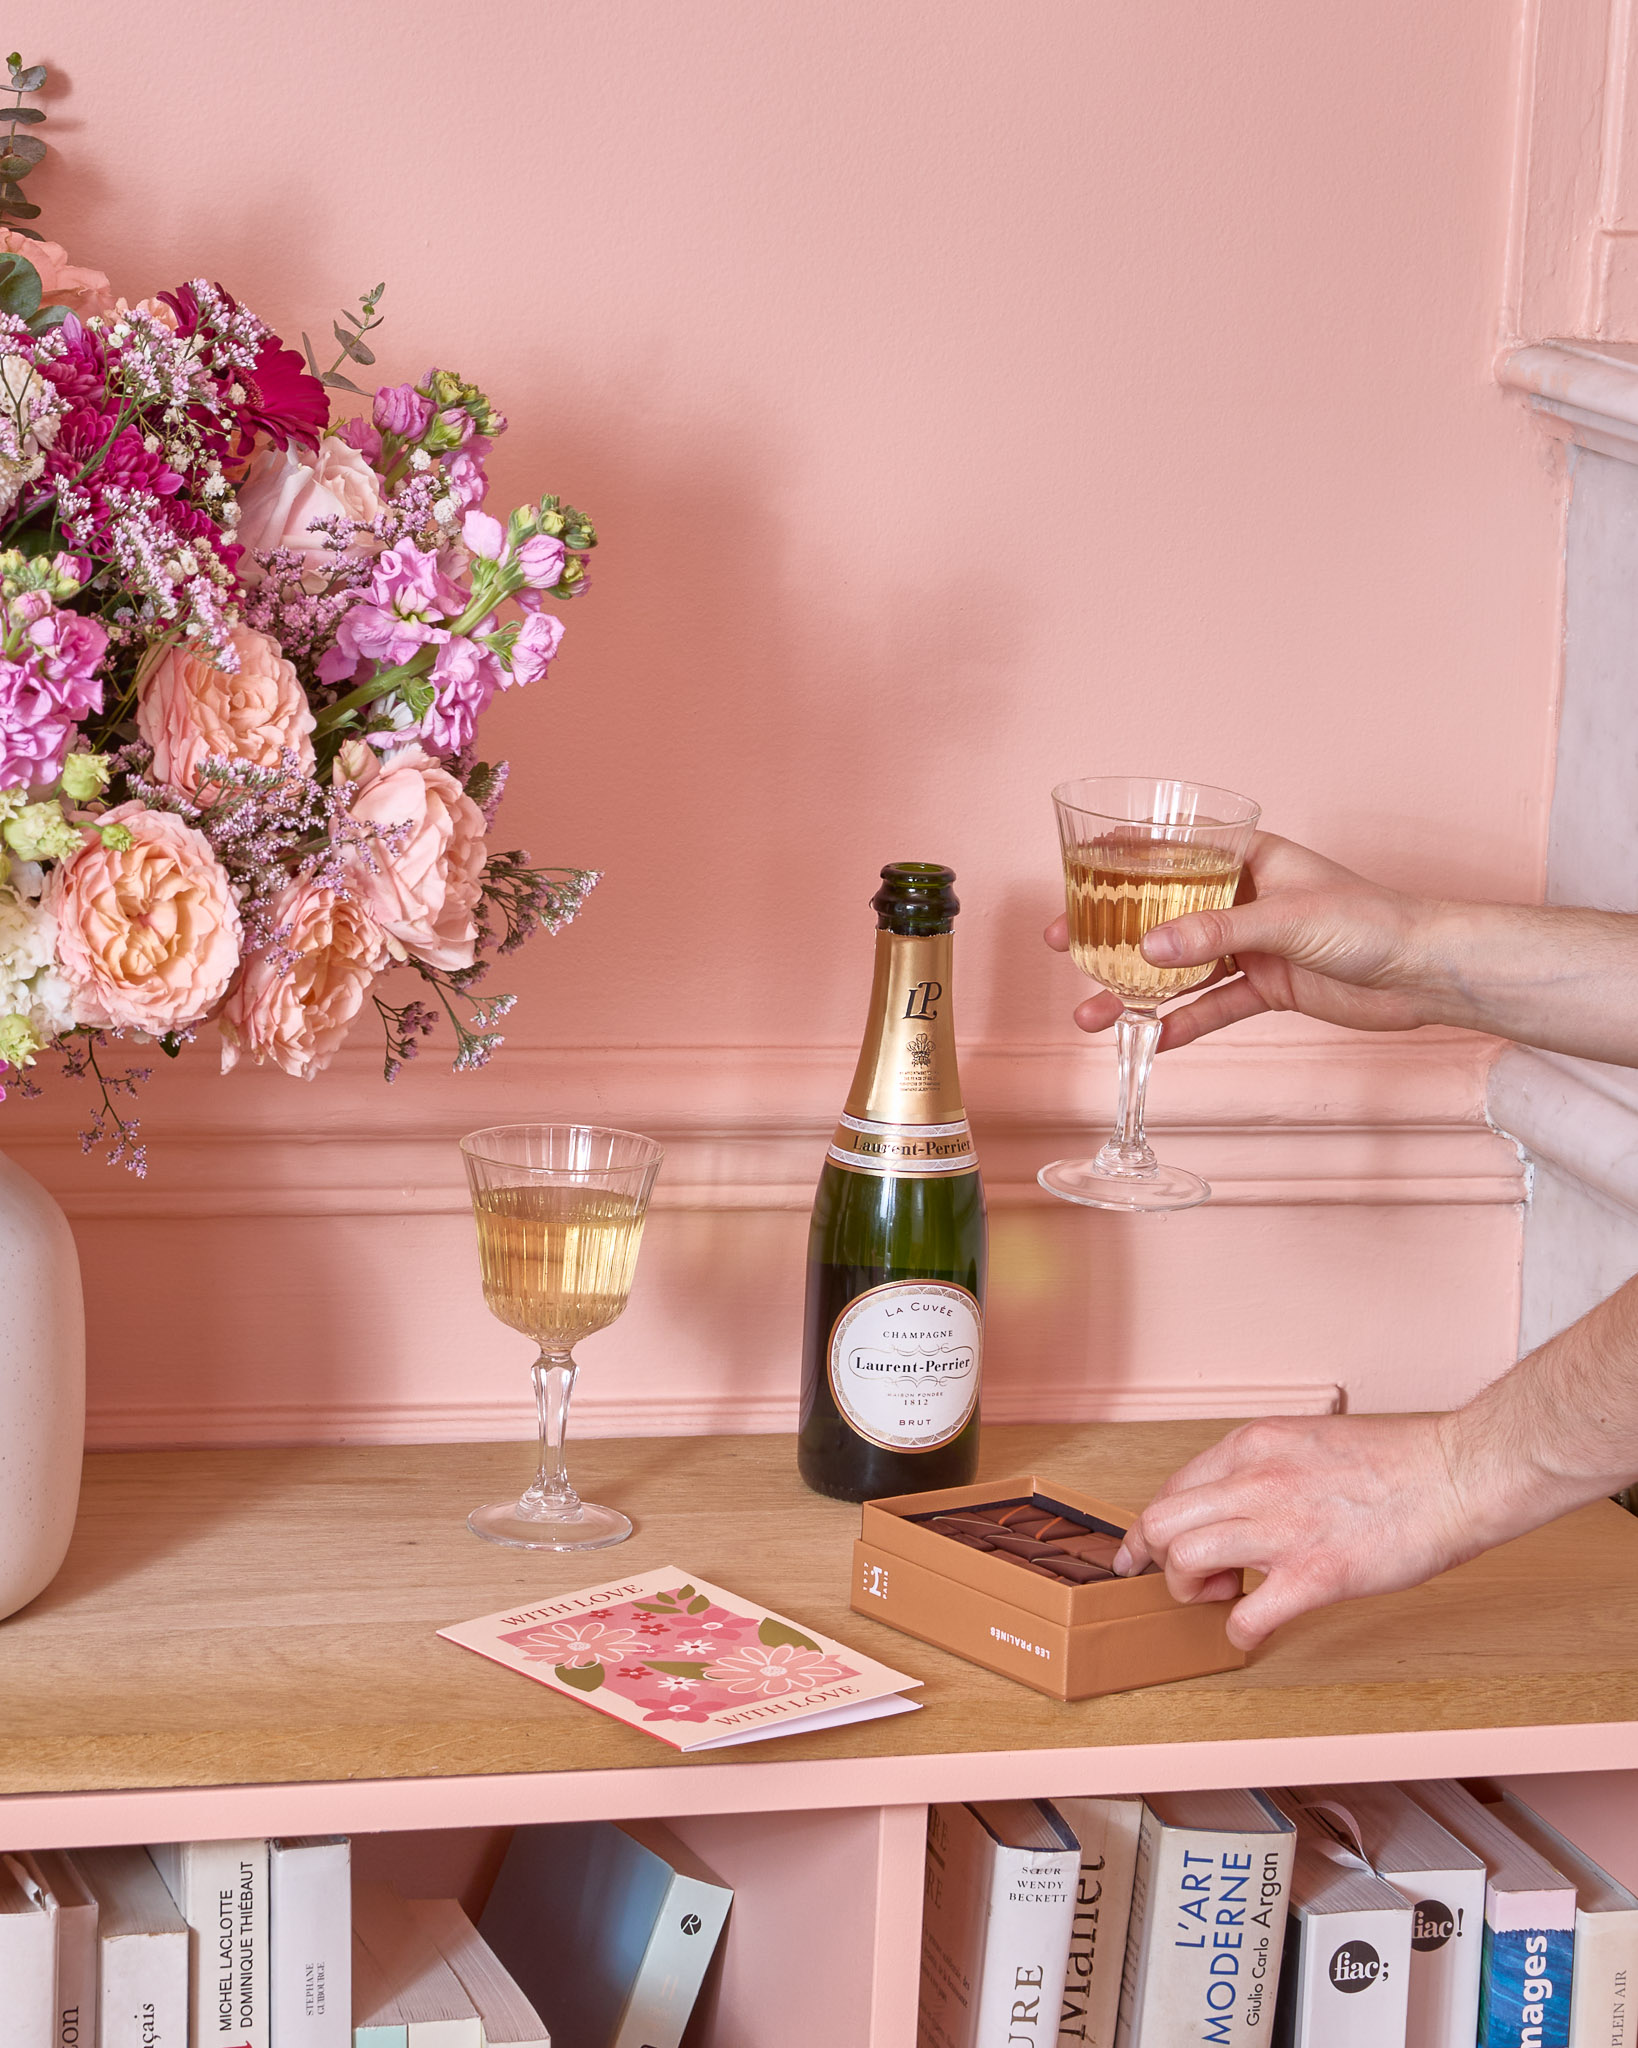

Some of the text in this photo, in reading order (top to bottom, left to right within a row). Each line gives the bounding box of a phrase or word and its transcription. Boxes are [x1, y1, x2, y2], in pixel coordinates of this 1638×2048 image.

[885, 1301, 953, 1318] LA CUVÉE
[882, 1329, 954, 1340] CHAMPAGNE
[856, 1356, 971, 1373] Laurent-Perrier
[898, 1418, 932, 1427] BRUT
[904, 1398, 929, 1406] 1812
[500, 1584, 644, 1626] WITH LOVE
[990, 1626, 1051, 1661] LES PRALINÉS
[714, 1684, 861, 1726] WITH LOVE
[1009, 1892, 1068, 1903] BECKETT
[1017, 1880, 1064, 1889] WENDY
[1174, 1849, 1214, 1948] L'ART
[219, 1889, 233, 2031] MICHEL LACLOTTE
[238, 1861, 254, 2028] DOMINIQUE THIÉBAUT
[1201, 1852, 1252, 2046] MODERNE
[1246, 1852, 1282, 2027] Giulio Carlo Argan
[305, 1963, 314, 2017] STEPHANE
[1611, 1970, 1627, 2047] PLEIN AIR
